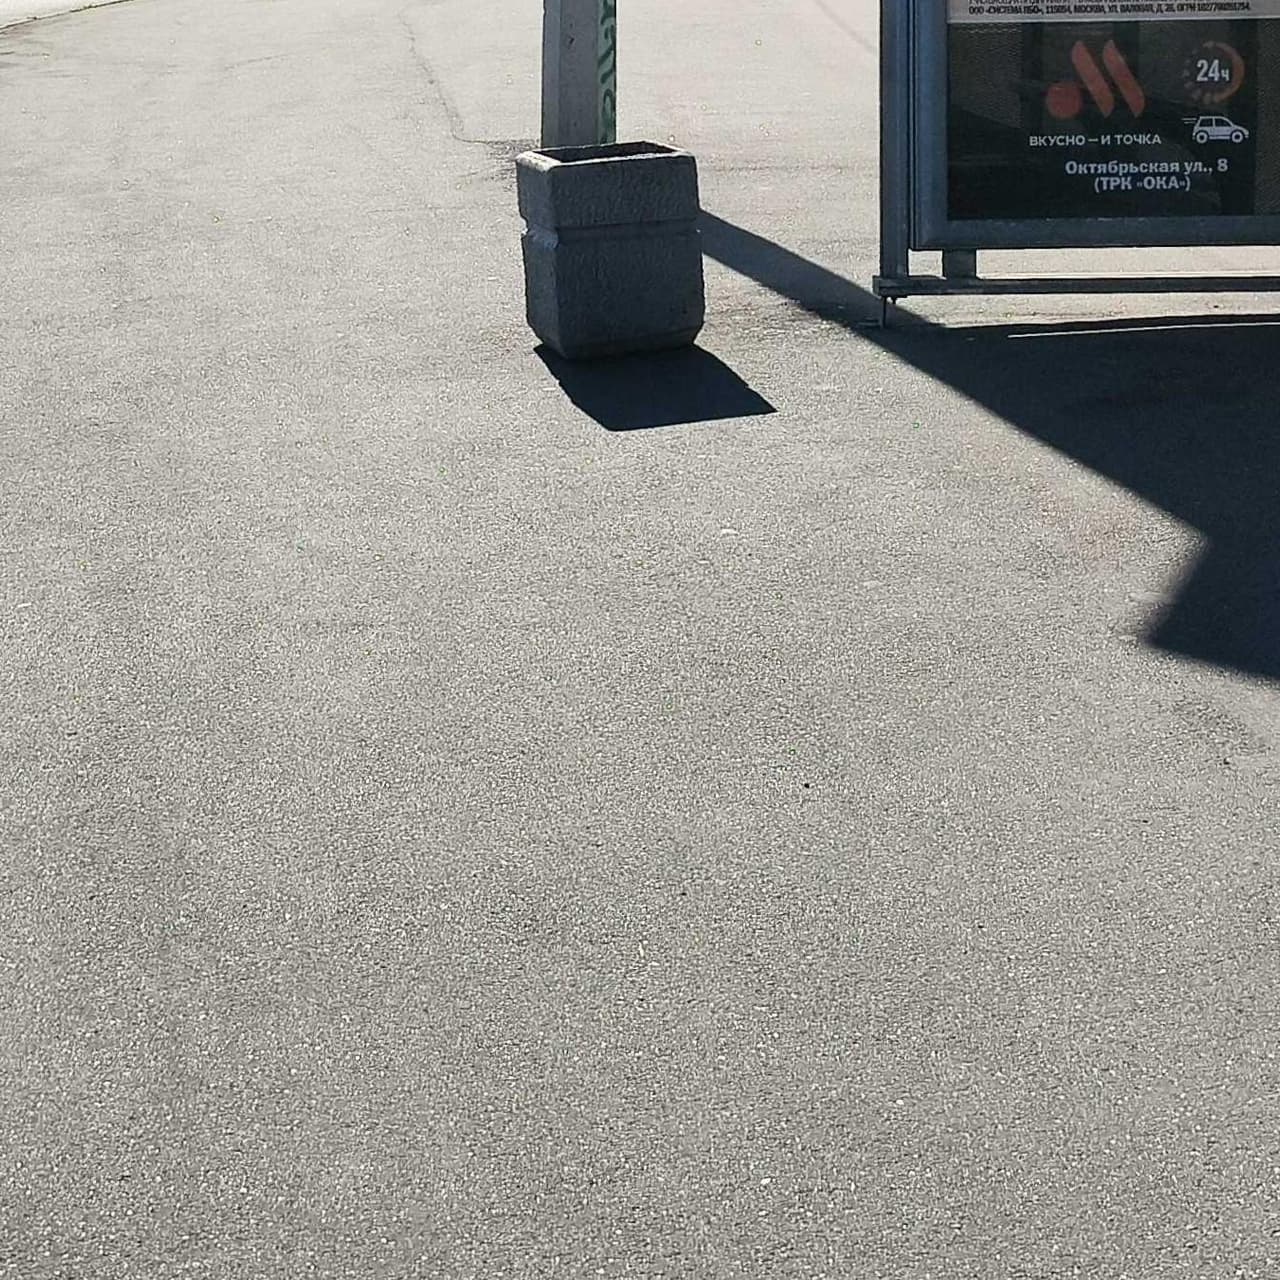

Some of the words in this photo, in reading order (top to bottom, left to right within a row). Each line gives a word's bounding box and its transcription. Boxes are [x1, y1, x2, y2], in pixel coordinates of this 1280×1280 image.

[1195, 59, 1231, 83] 24ч
[1029, 134, 1086, 146] ВКУСНО
[1101, 134, 1111, 145] И
[1113, 133, 1163, 145] ТОЧКА
[1065, 158, 1180, 176] Октябрьская
[1183, 161, 1213, 176] ул.,
[1217, 158, 1229, 172] 8
[1093, 176, 1132, 193] (ТРК
[1136, 174, 1191, 192] «ОКА»)
